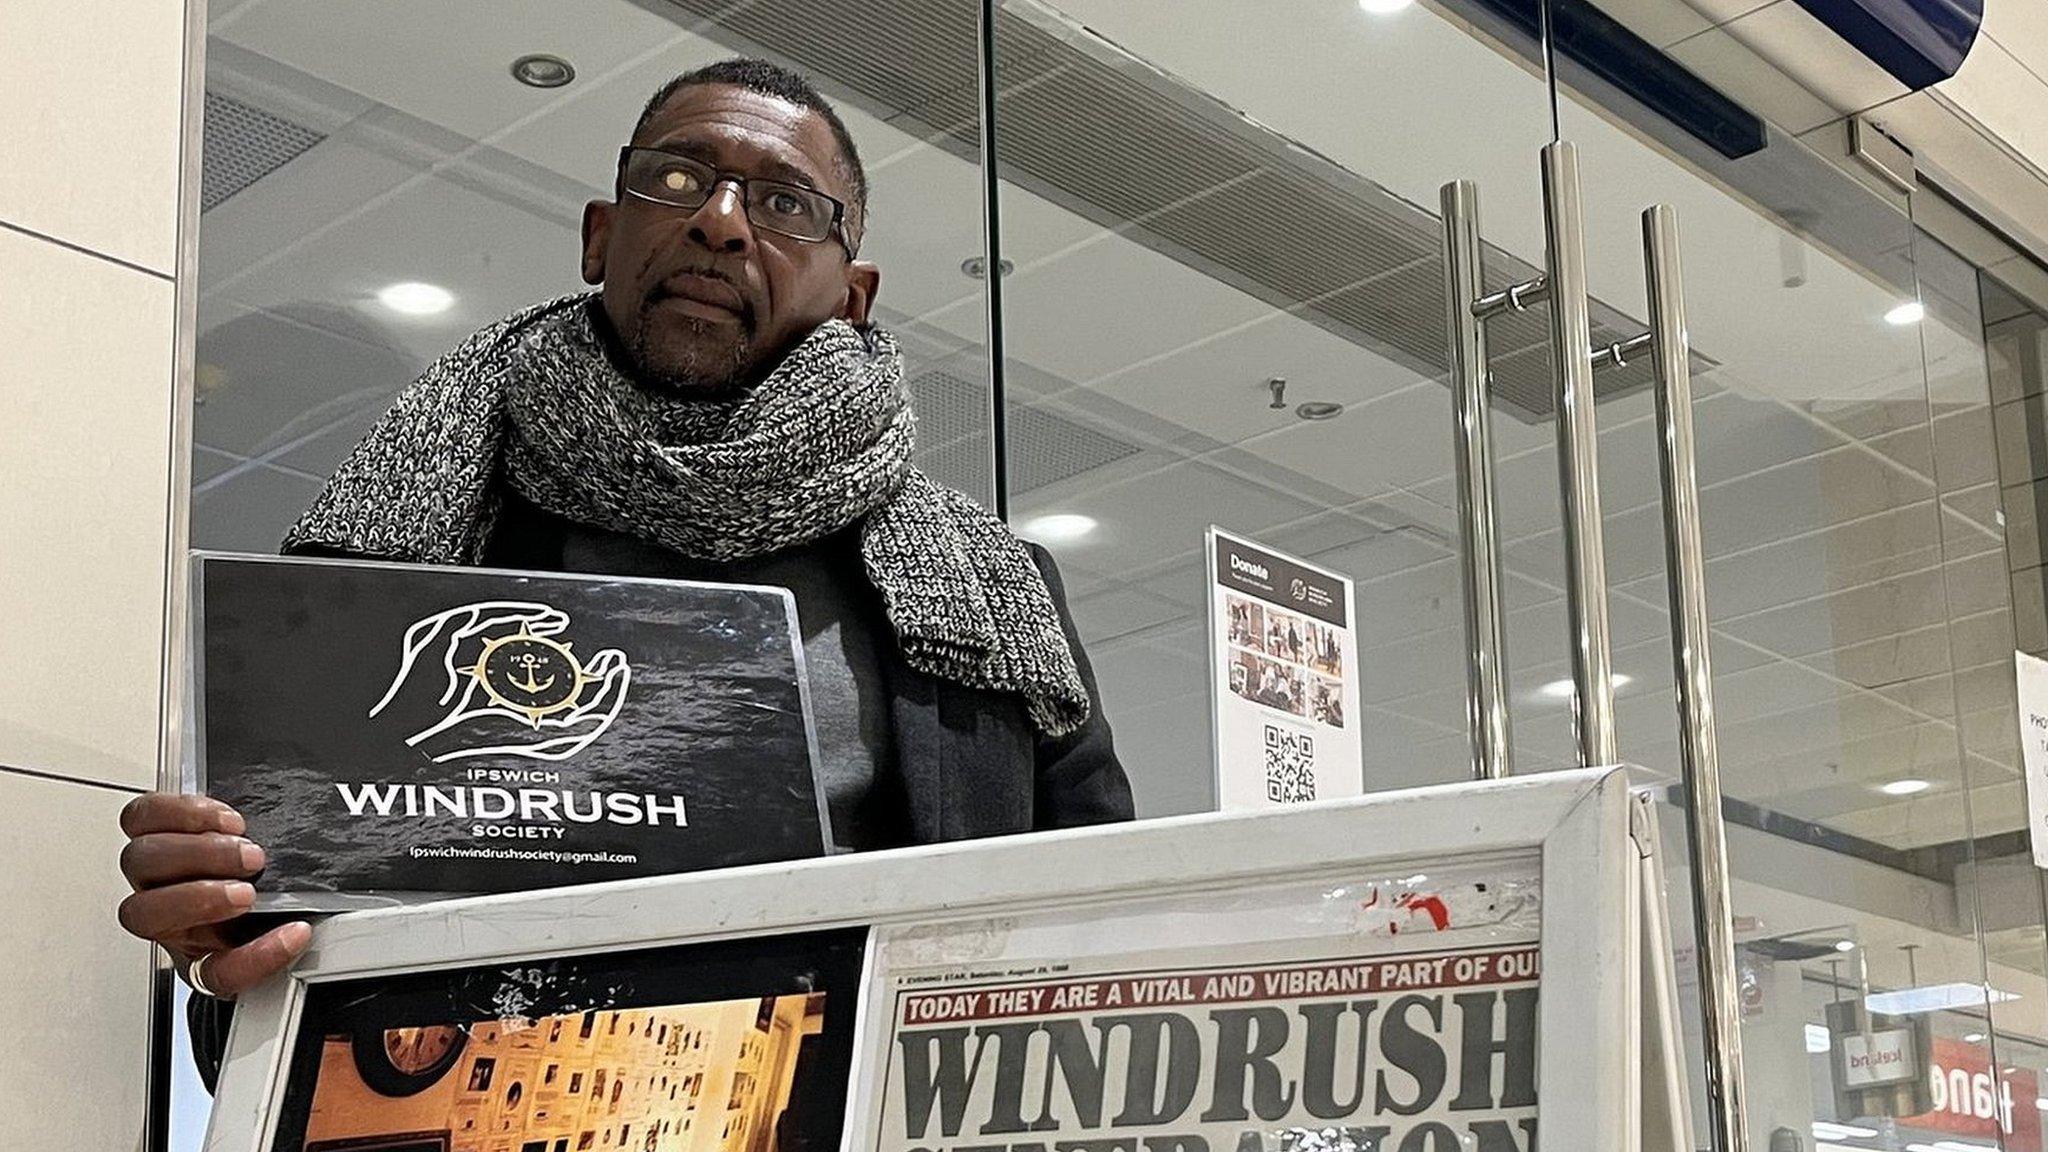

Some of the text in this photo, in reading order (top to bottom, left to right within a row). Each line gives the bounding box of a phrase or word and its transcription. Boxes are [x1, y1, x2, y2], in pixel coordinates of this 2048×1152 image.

[1230, 553, 1269, 581] Donate
[467, 768, 560, 784] IPSWICH
[336, 783, 689, 827] WINDRUSH
[472, 824, 566, 839] SOCIETY
[909, 952, 1540, 1019] TODAY THEY ARE A VITAL AND VIBRANT PART OF OU
[897, 987, 1539, 1139] WINDRUSH
